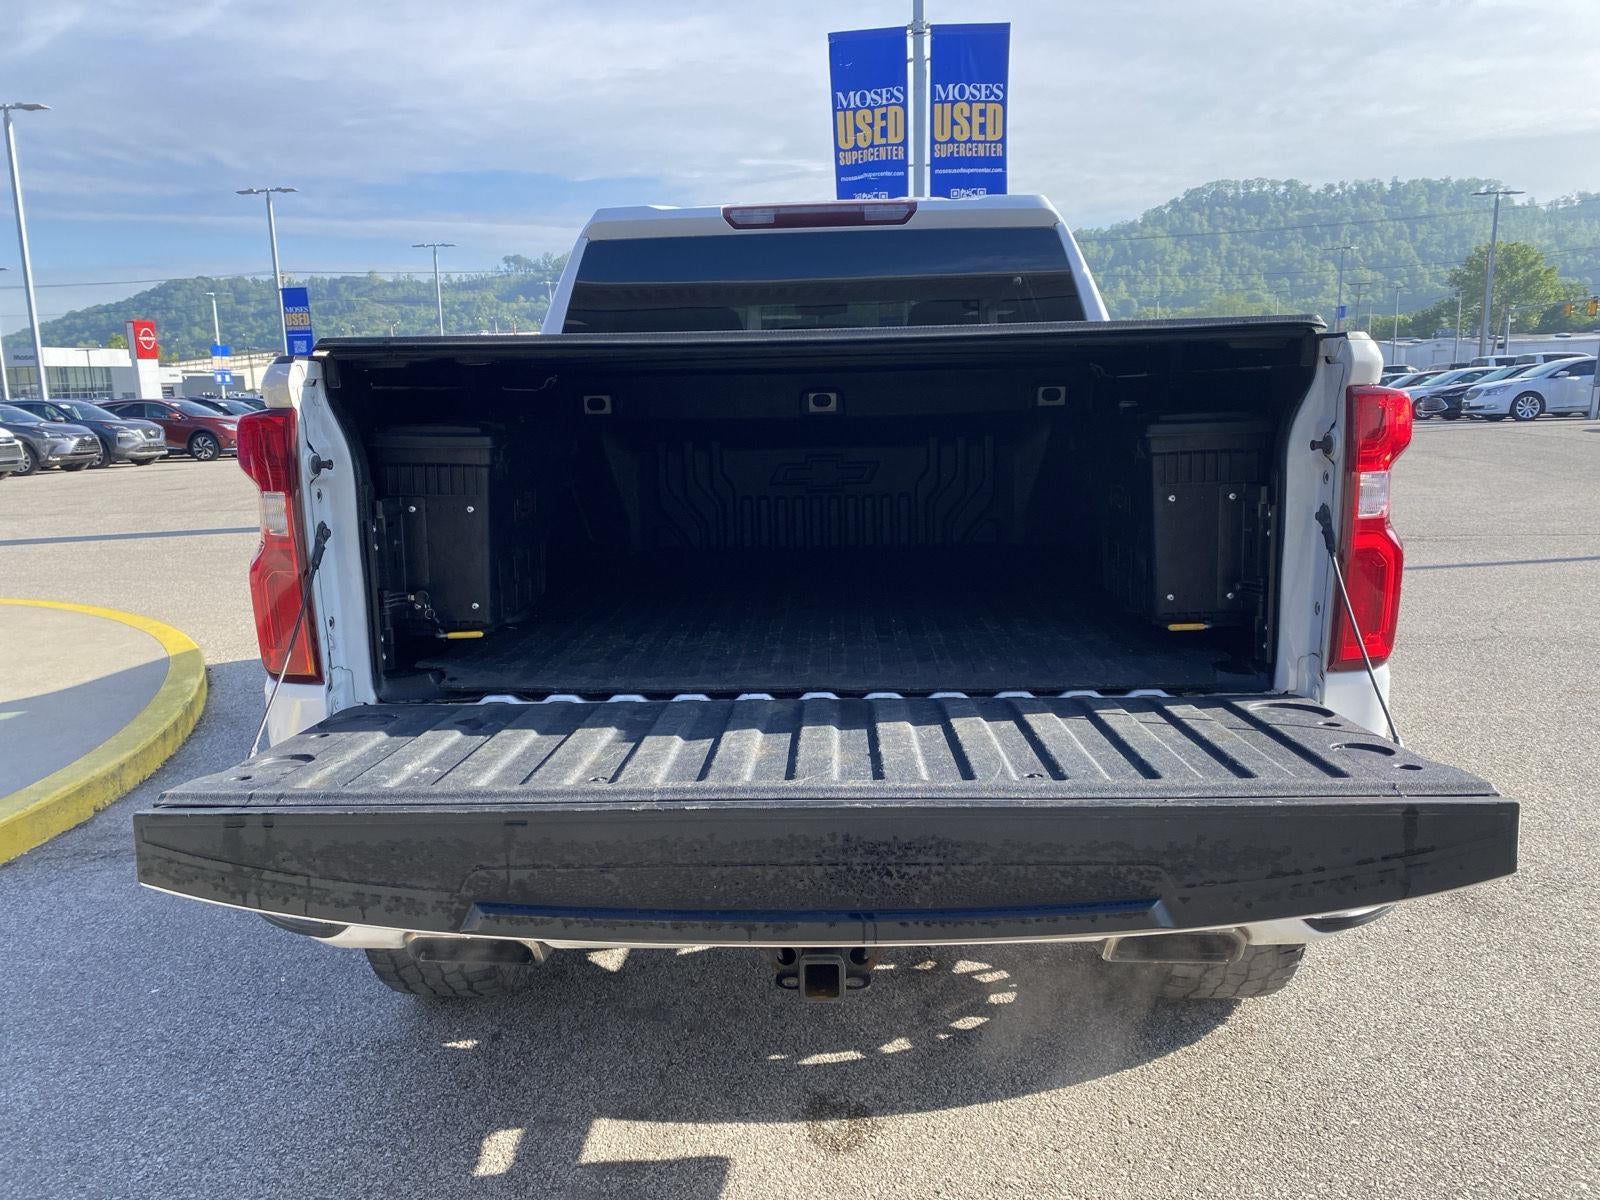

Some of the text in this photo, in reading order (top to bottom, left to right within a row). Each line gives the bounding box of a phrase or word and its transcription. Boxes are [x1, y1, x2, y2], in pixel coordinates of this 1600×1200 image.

[836, 86, 904, 110] MOSES
[934, 83, 1004, 101] MOSES
[836, 105, 905, 149] USED
[933, 102, 1004, 142] USED
[839, 146, 905, 166] SUPERCENTER
[934, 143, 1003, 158] SUPERCENTER
[285, 305, 309, 313] MOSES
[285, 313, 310, 326] USED
